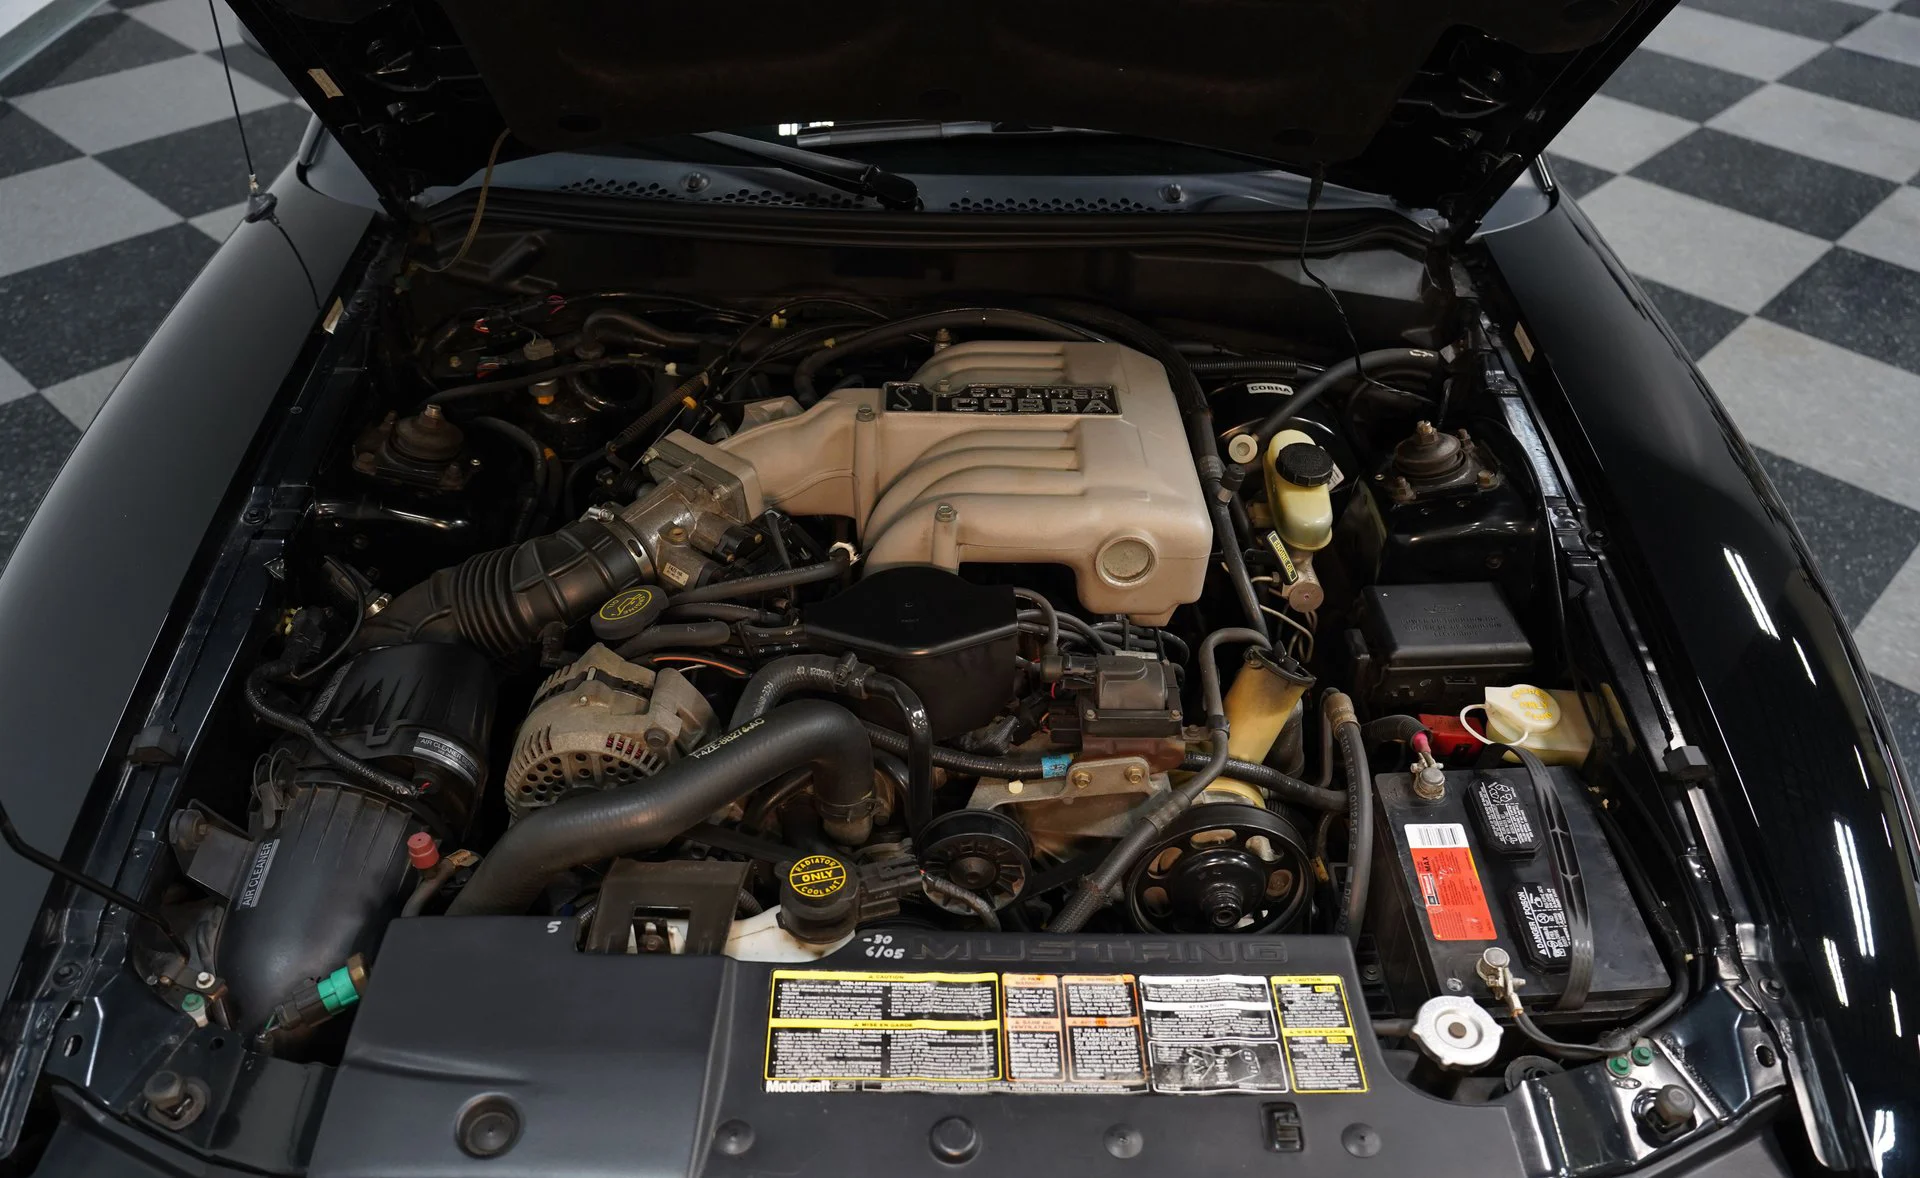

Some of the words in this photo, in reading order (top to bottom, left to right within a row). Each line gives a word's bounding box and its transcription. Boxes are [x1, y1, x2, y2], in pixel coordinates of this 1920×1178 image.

[1250, 384, 1291, 394] COBRA
[952, 398, 1113, 412] COBRA
[1273, 540, 1288, 563] ENGINE
[433, 741, 462, 759] CLEANER
[796, 858, 836, 873] RADIATOR
[1422, 856, 1431, 872] MAX
[242, 889, 256, 906] AIR
[249, 842, 273, 888] CLEANER
[802, 870, 833, 883] ONLY
[801, 880, 841, 896] COOLANT
[1517, 891, 1533, 916] POISON
[863, 934, 893, 945] -30
[1528, 921, 1545, 949] DANGER
[865, 945, 905, 959] 6/05
[911, 938, 1288, 962] MUSTANG
[766, 1080, 830, 1093] Motorcraft
